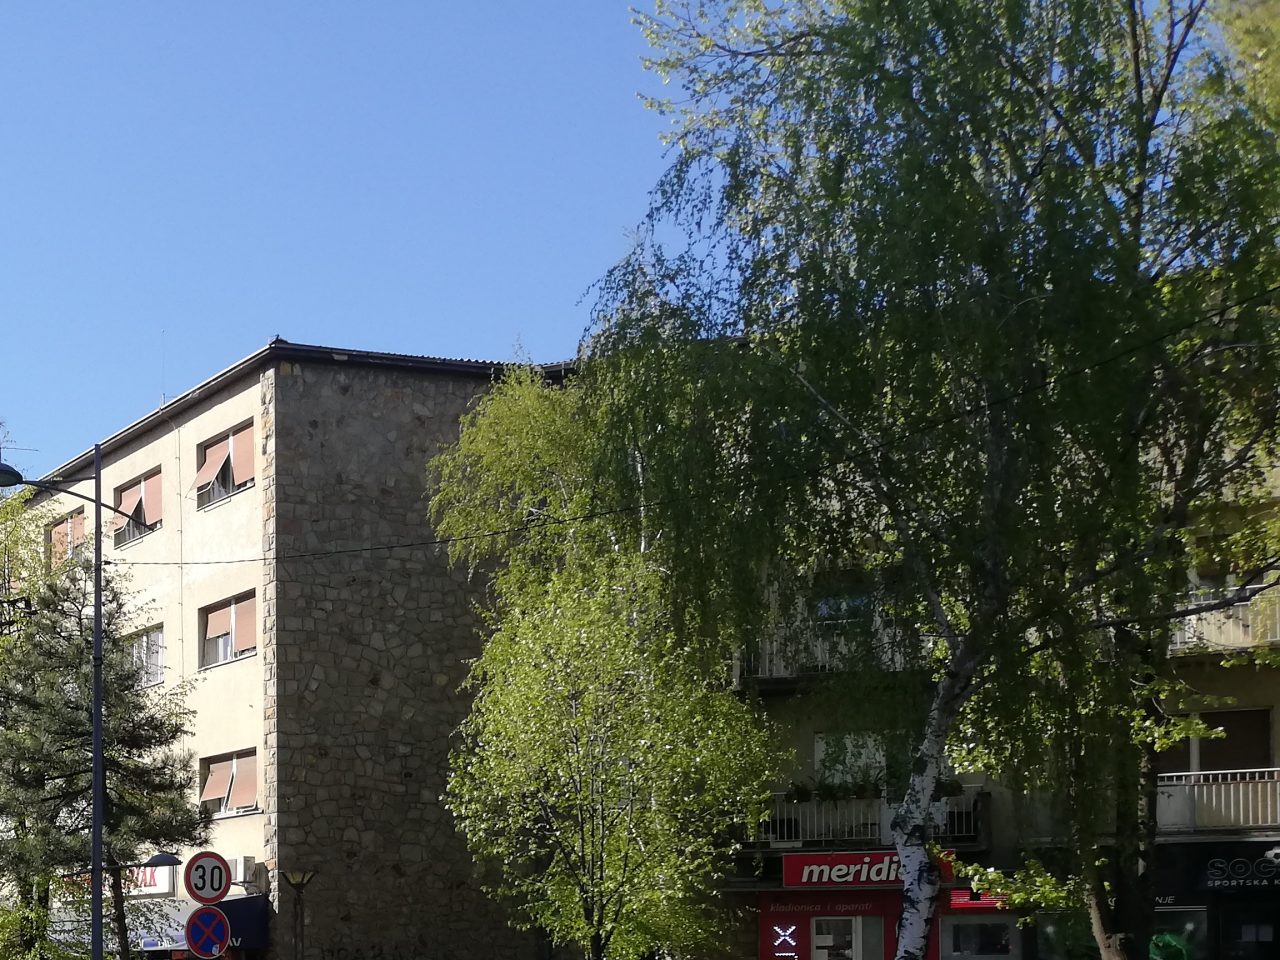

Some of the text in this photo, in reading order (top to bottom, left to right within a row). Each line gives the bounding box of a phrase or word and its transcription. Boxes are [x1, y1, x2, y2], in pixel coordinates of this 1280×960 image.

[194, 864, 223, 892] 30
[801, 856, 904, 883] meridi
[1207, 857, 1280, 880] SOC
[1207, 879, 1269, 887] SPORTSKA
[769, 903, 821, 912] kladionica
